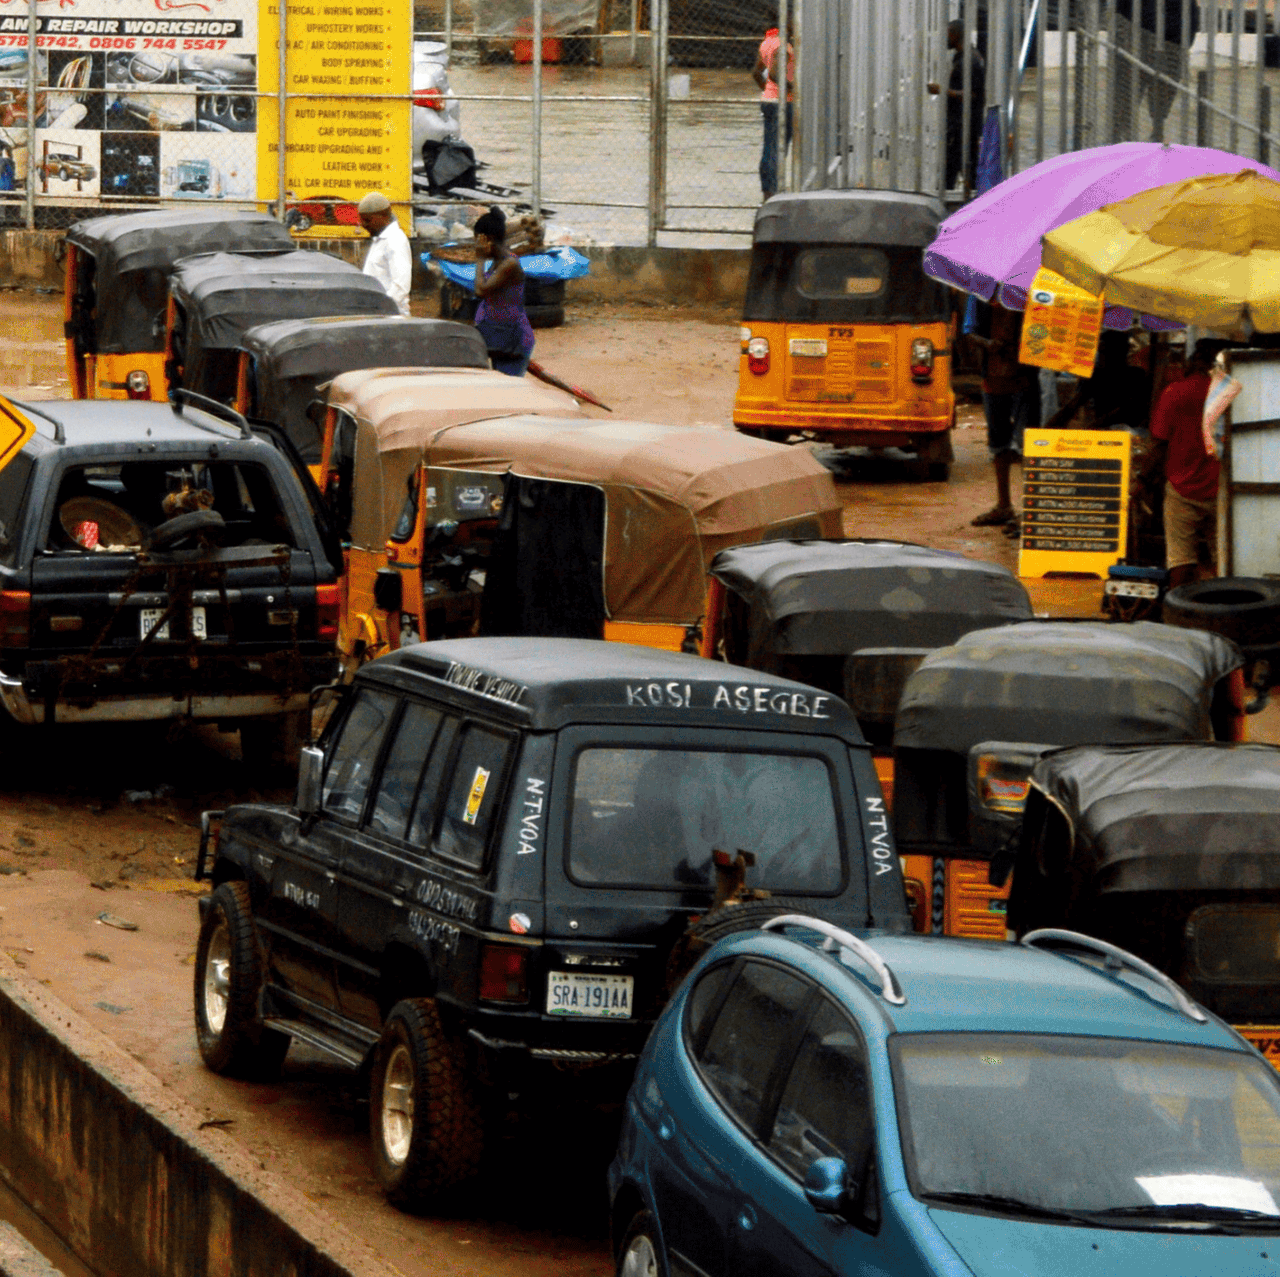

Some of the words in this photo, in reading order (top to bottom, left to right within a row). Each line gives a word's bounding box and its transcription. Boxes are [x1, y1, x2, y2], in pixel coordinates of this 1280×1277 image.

[267, 6, 316, 15] ELTRICAL
[356, 6, 384, 16] WORKS
[48, 18, 119, 33] REPAIR
[124, 20, 237, 35] WORKSHOP
[355, 24, 384, 34] WORKS
[89, 37, 137, 49] 0806
[143, 38, 177, 50] 744
[183, 39, 227, 51] 5547
[275, 40, 291, 49] CR
[327, 41, 384, 51] CONDITIONING
[268, 143, 316, 153] DABOARD
[322, 161, 357, 171] LEATHER
[359, 162, 383, 172] WORK
[304, 178, 320, 188] CAR
[322, 178, 352, 188] REPAIR
[626, 682, 692, 709] KOSI
[553, 984, 628, 1008] SRA-191AA
